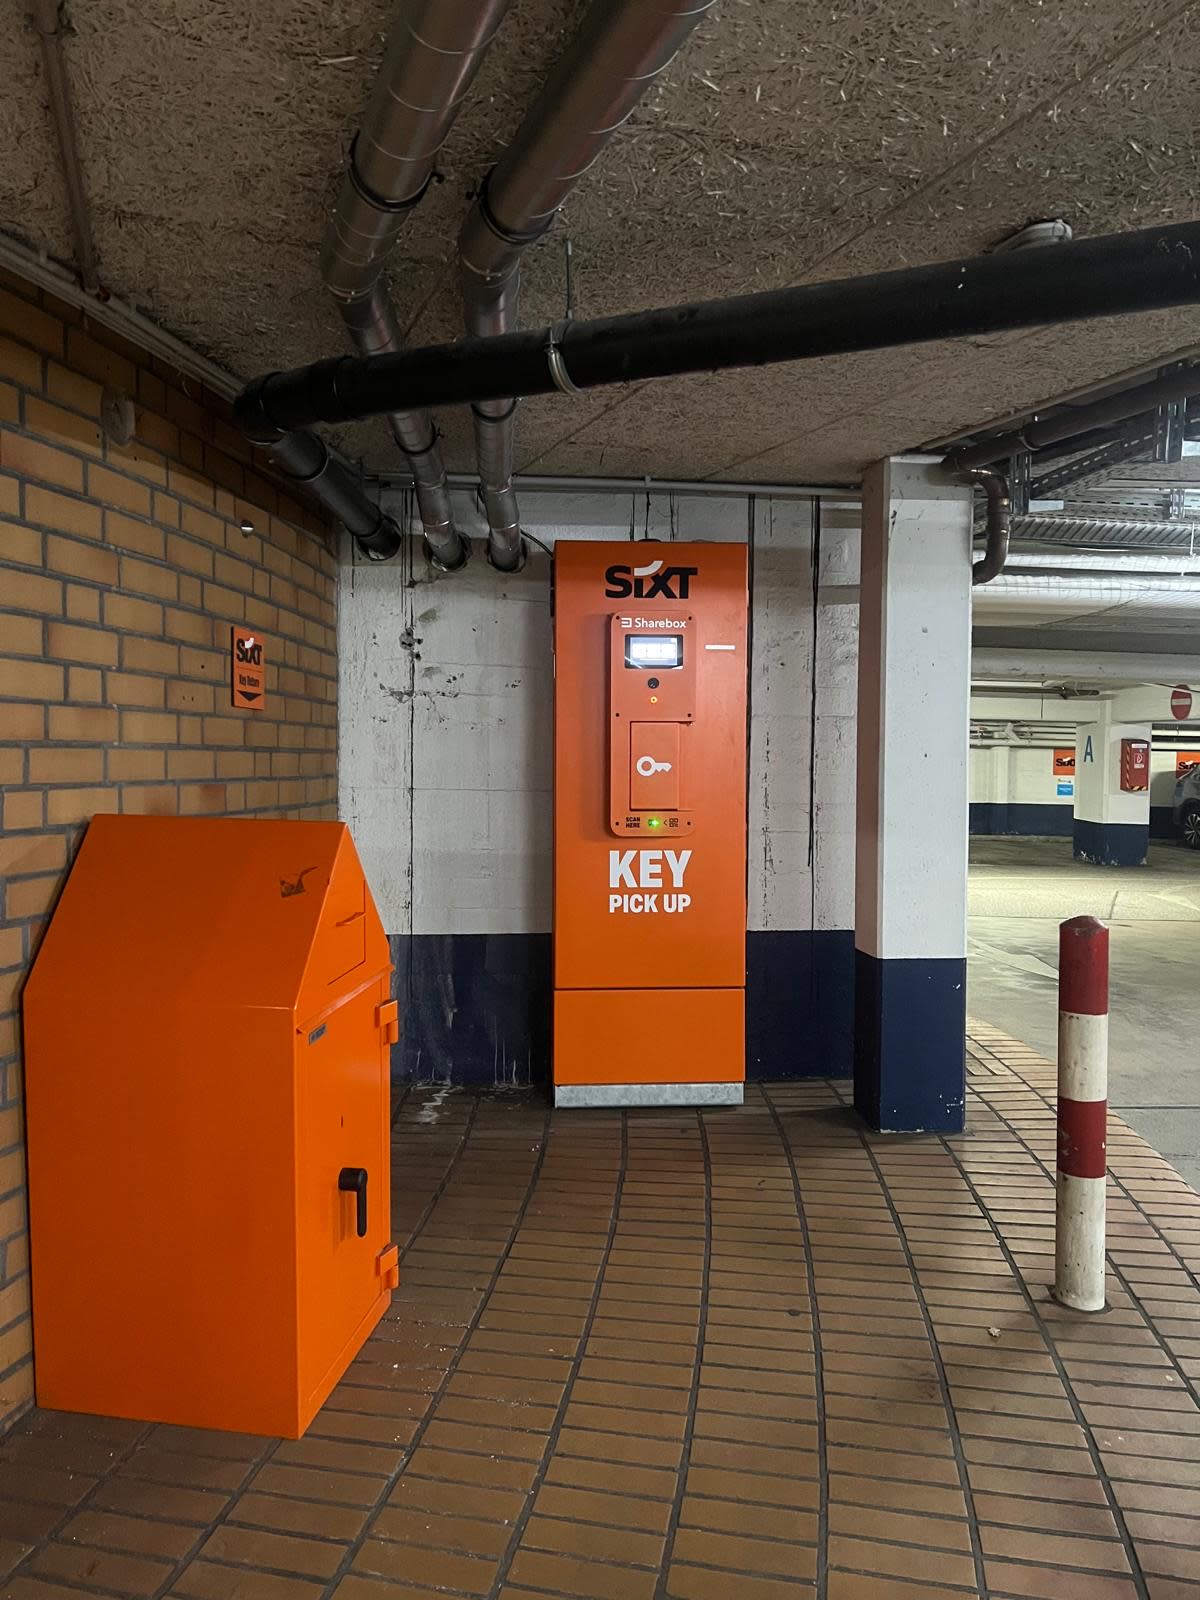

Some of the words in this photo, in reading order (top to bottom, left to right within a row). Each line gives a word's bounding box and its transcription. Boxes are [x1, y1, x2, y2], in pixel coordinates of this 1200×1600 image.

[635, 617, 687, 628] Sharebox
[1083, 735, 1094, 763] A
[609, 850, 693, 888] KEY
[609, 894, 659, 913] PICK
[663, 894, 691, 913] UP
